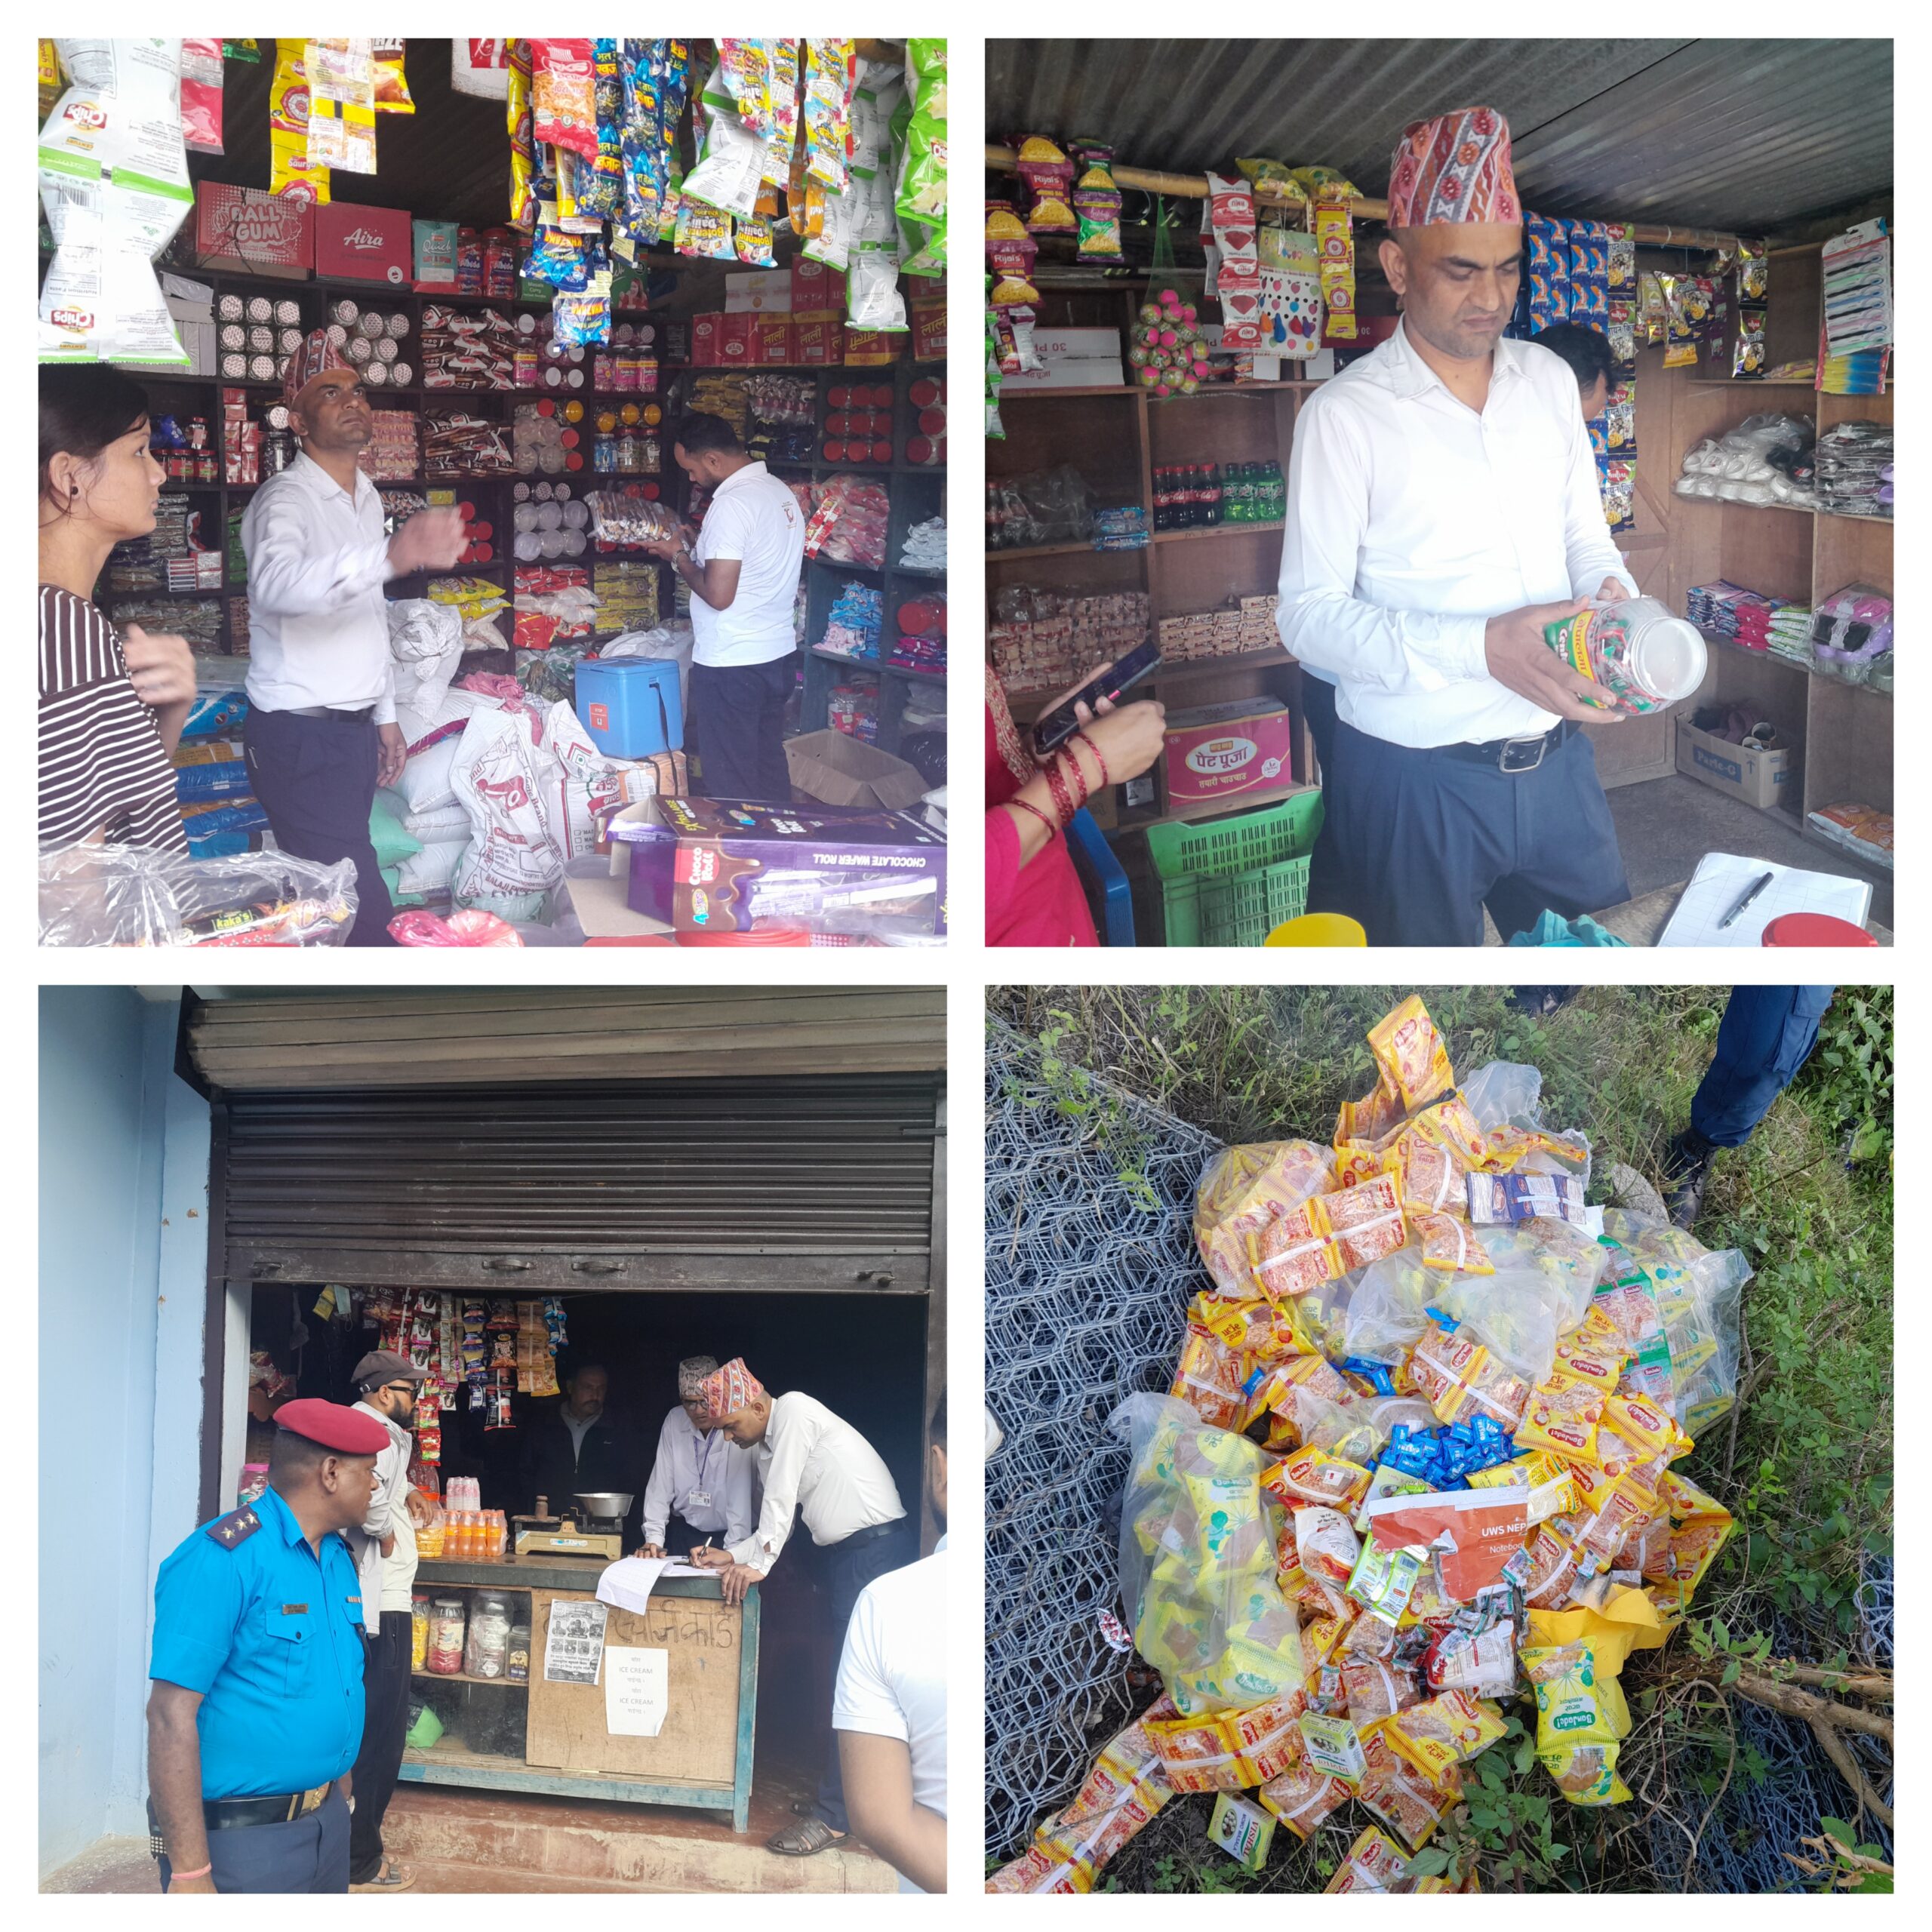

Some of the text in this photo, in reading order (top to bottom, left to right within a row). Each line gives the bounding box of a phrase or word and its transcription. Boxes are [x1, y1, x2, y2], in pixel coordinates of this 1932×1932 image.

[230, 204, 280, 223] BALL
[236, 223, 280, 240] GUM
[343, 228, 383, 247] Aira
[422, 238, 451, 254] Quick
[54, 310, 91, 327] Chips
[1053, 343, 1066, 351] 30
[1195, 750, 1217, 768] पेट
[1220, 746, 1248, 769] पूजा
[1698, 749, 1736, 775] Parle-G
[813, 854, 927, 868] CHOCOLATE WAFER ROLL
[217, 912, 250, 929] kaka's
[1481, 1526, 1505, 1537] UWS
[1556, 1714, 1592, 1727] BanJade!
[1244, 1820, 1259, 1857] VISHAL
